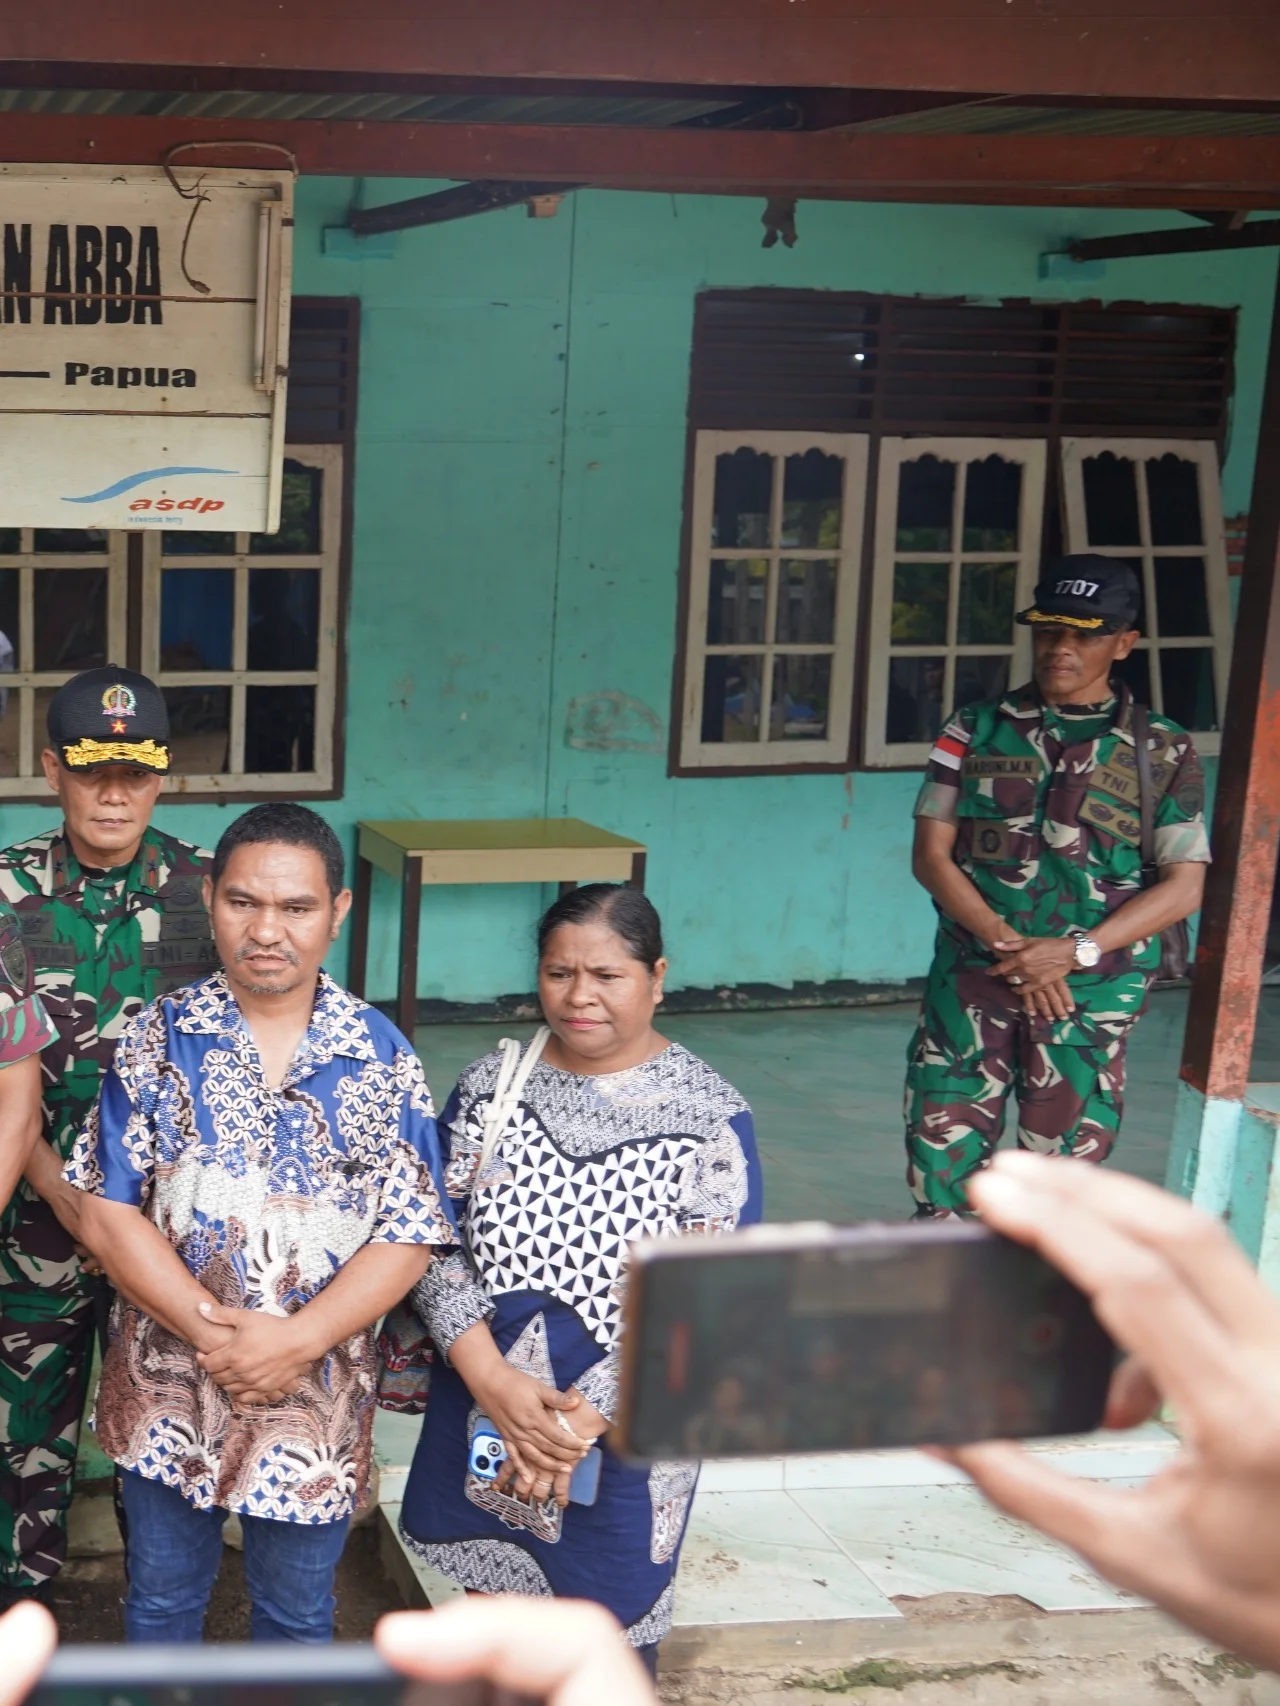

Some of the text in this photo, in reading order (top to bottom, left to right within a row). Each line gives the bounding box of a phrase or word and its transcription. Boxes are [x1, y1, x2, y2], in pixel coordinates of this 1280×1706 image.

[43, 223, 163, 326] ABBA
[64, 361, 198, 390] Papua
[128, 497, 225, 514] asdp
[1055, 579, 1100, 598] 1707
[1102, 771, 1130, 794] TNI
